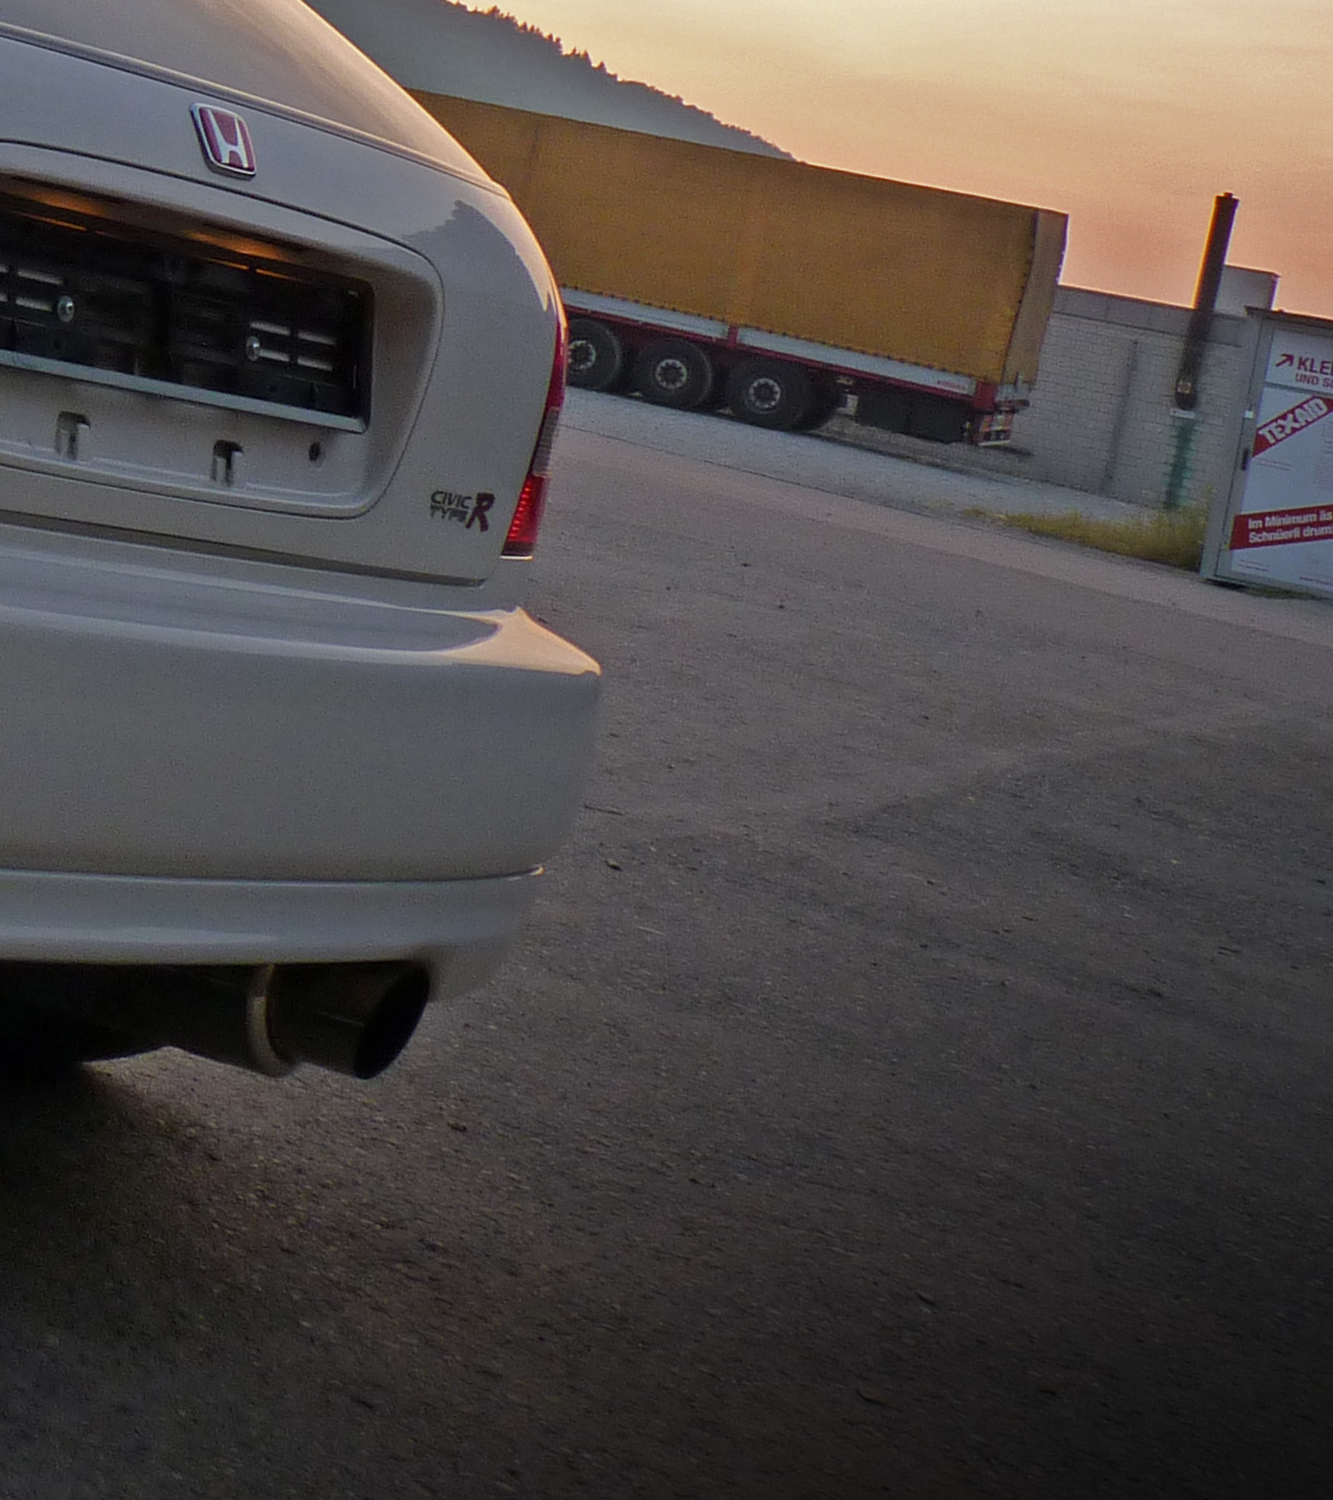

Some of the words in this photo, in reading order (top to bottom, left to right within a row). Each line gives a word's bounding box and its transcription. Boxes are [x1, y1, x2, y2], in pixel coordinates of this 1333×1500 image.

[1295, 373, 1319, 386] UND
[1258, 398, 1328, 444] TEXAID
[430, 490, 472, 509] CIVIC
[430, 504, 469, 523] TYPE
[465, 492, 496, 532] R
[1248, 518, 1263, 529] Im
[1264, 513, 1317, 527] Minimum
